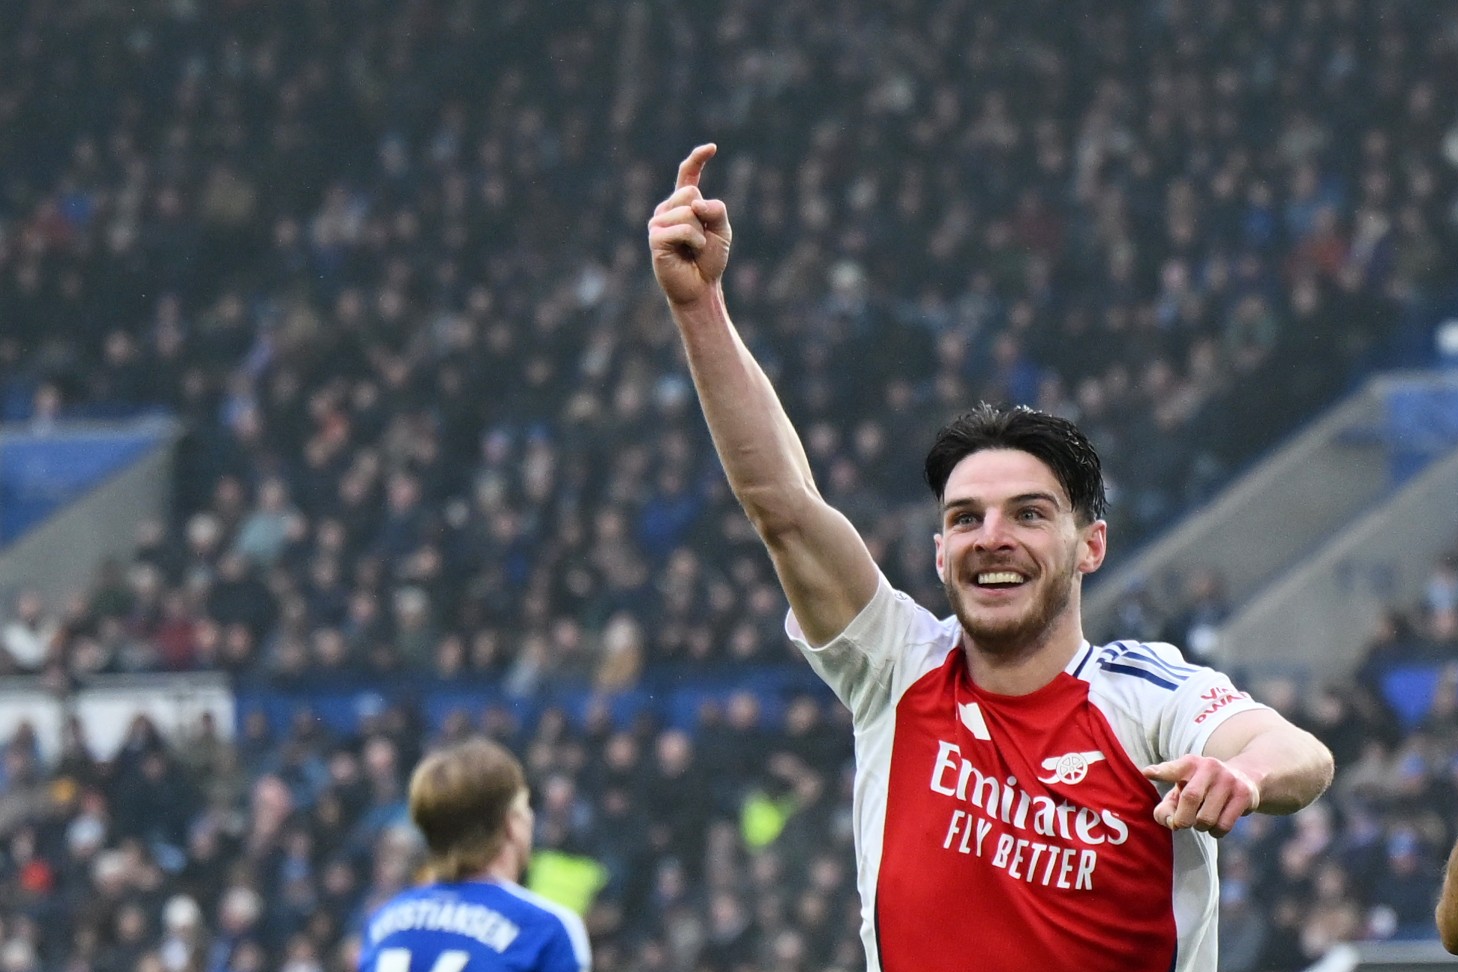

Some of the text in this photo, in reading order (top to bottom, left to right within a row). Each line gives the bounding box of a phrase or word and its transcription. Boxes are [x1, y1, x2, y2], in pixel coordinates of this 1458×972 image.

[930, 739, 1129, 846] Emirates
[943, 809, 1098, 890] FLY BETTER
